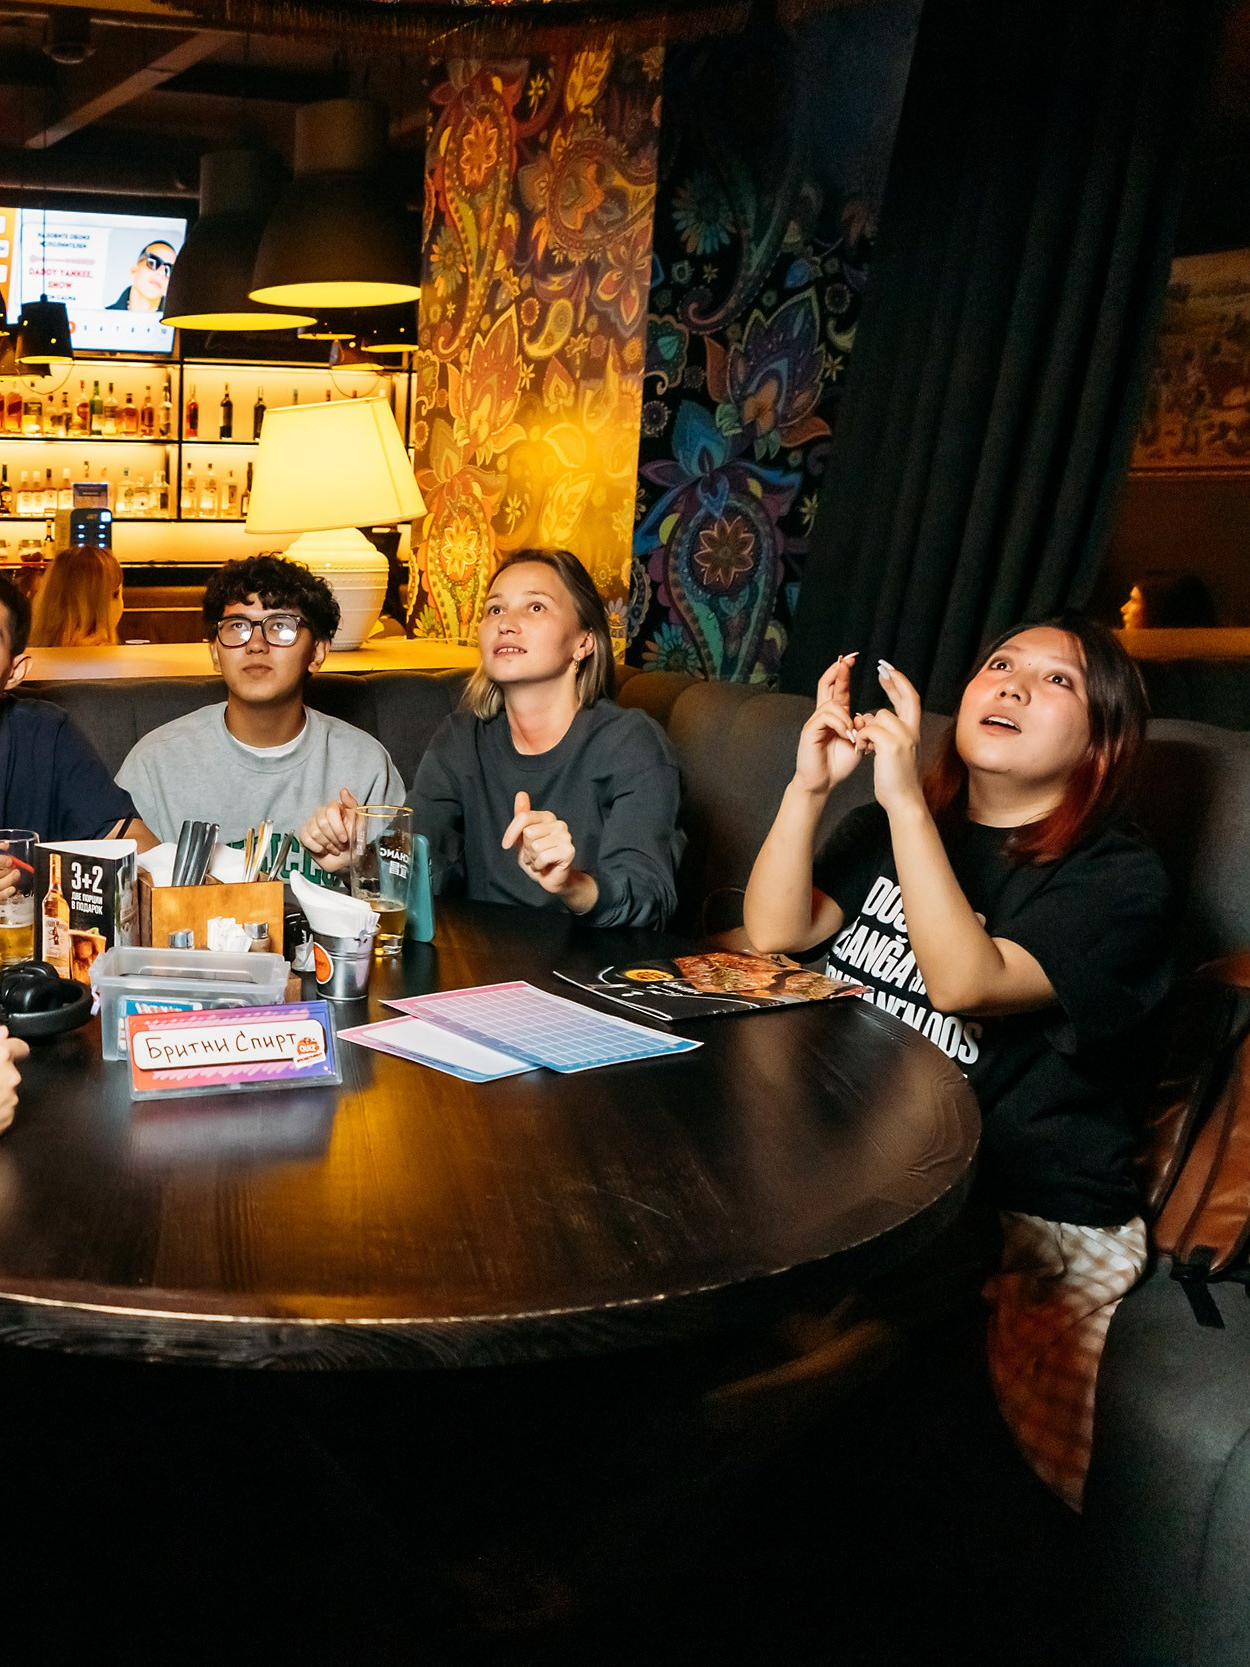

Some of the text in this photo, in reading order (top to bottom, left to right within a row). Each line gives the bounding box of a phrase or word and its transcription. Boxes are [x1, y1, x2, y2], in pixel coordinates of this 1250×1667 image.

[71, 861, 104, 894] 3+2
[76, 902, 104, 915] ПОДАРОК
[145, 1030, 297, 1063] Бритни Спирт
